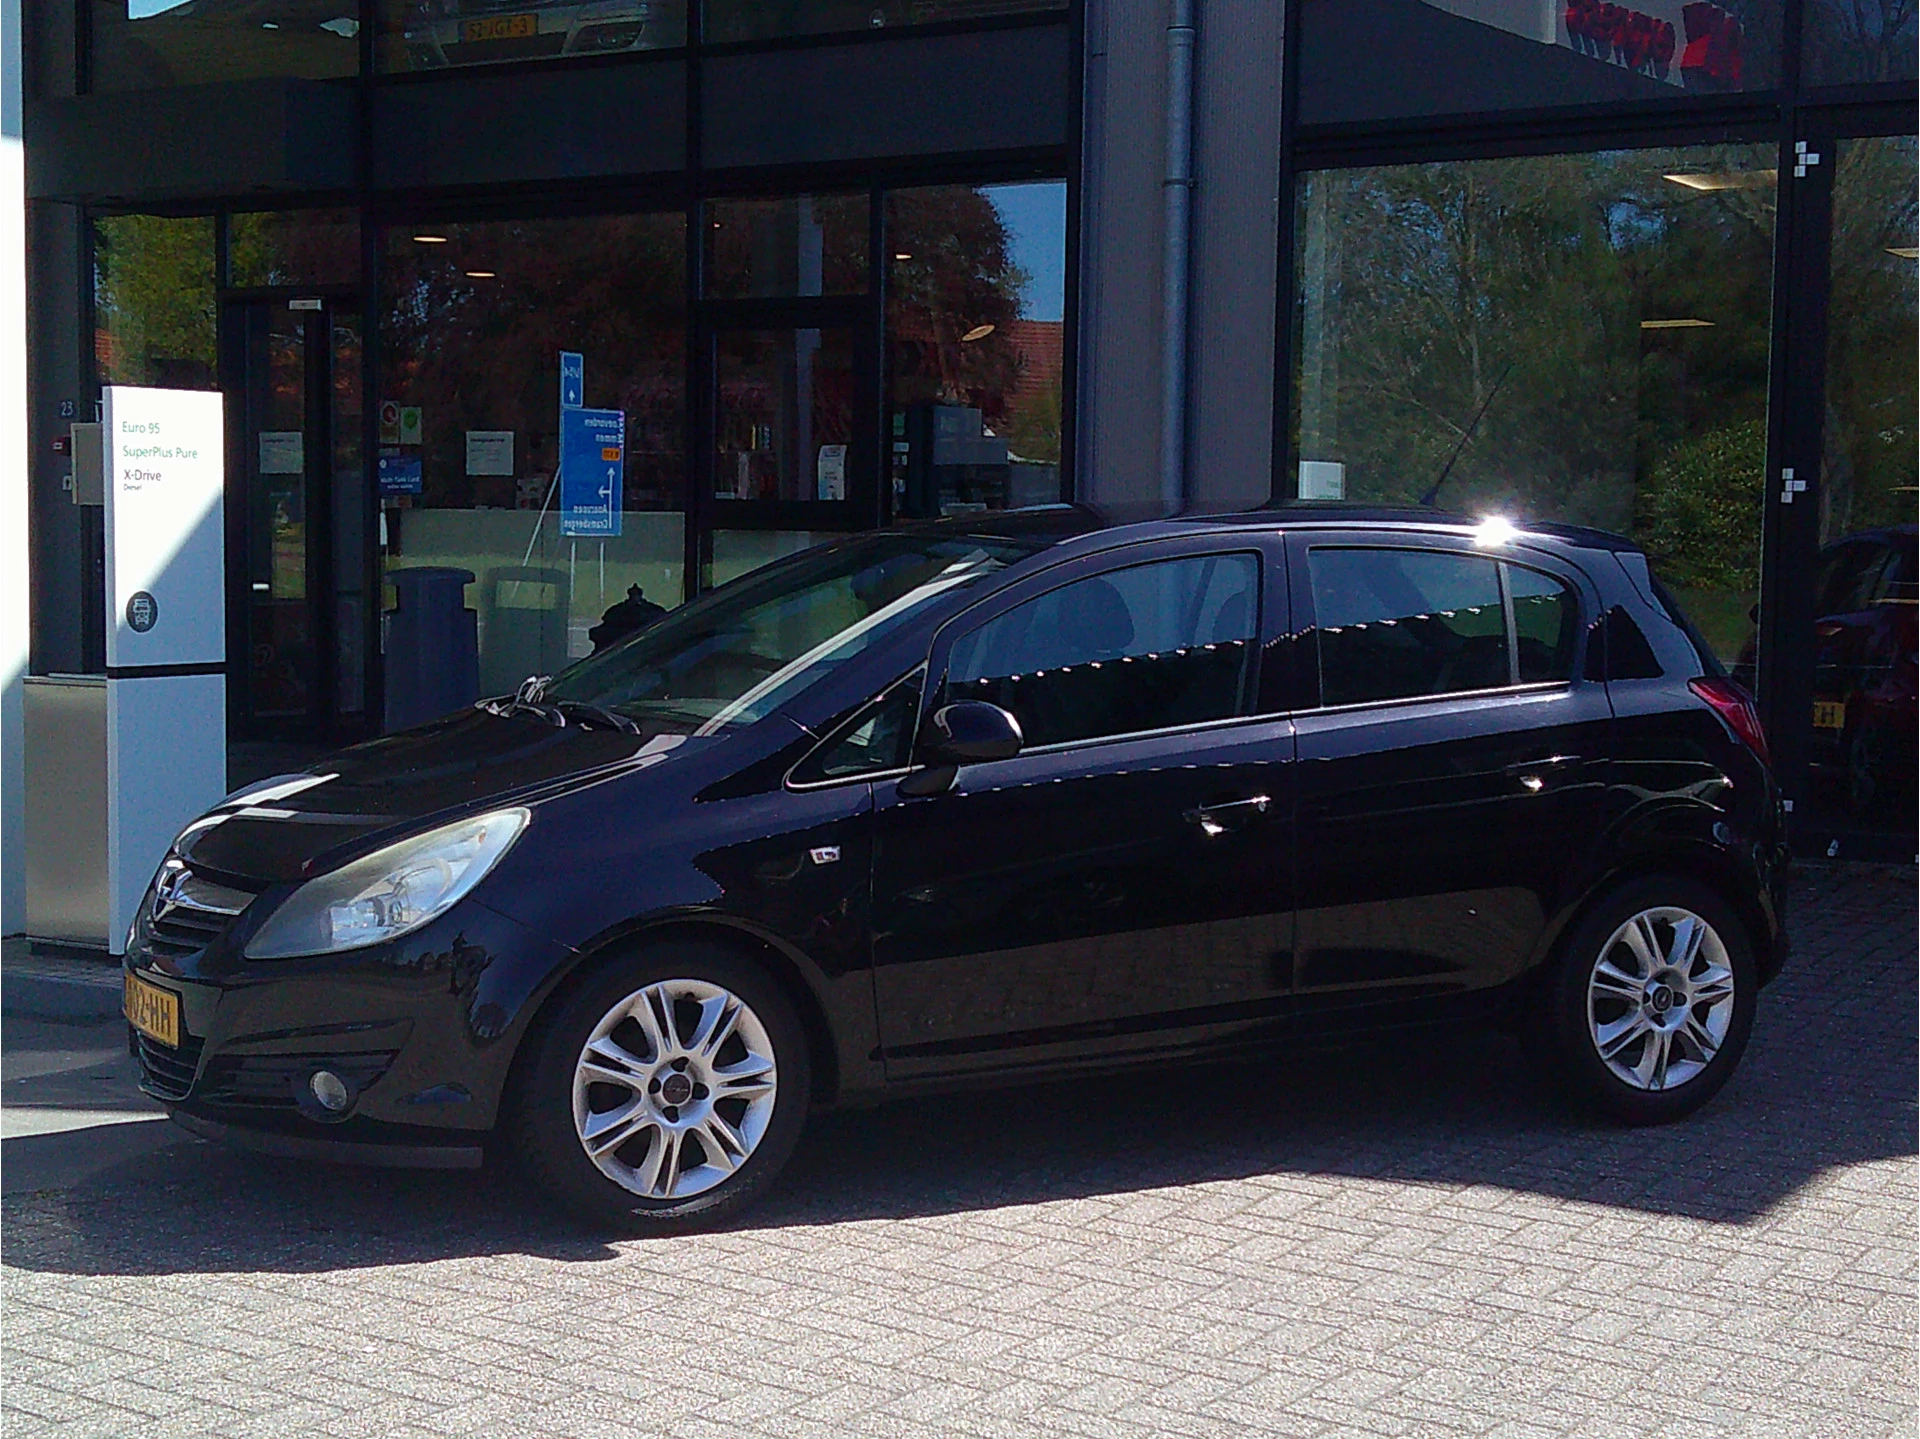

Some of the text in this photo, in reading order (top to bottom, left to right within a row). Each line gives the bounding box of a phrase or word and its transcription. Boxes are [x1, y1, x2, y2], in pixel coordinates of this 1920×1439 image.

[61, 401, 74, 416] 23
[122, 421, 160, 434] Euro 95
[123, 445, 198, 459] SuperPlus Pure
[124, 469, 162, 481] X-Drive
